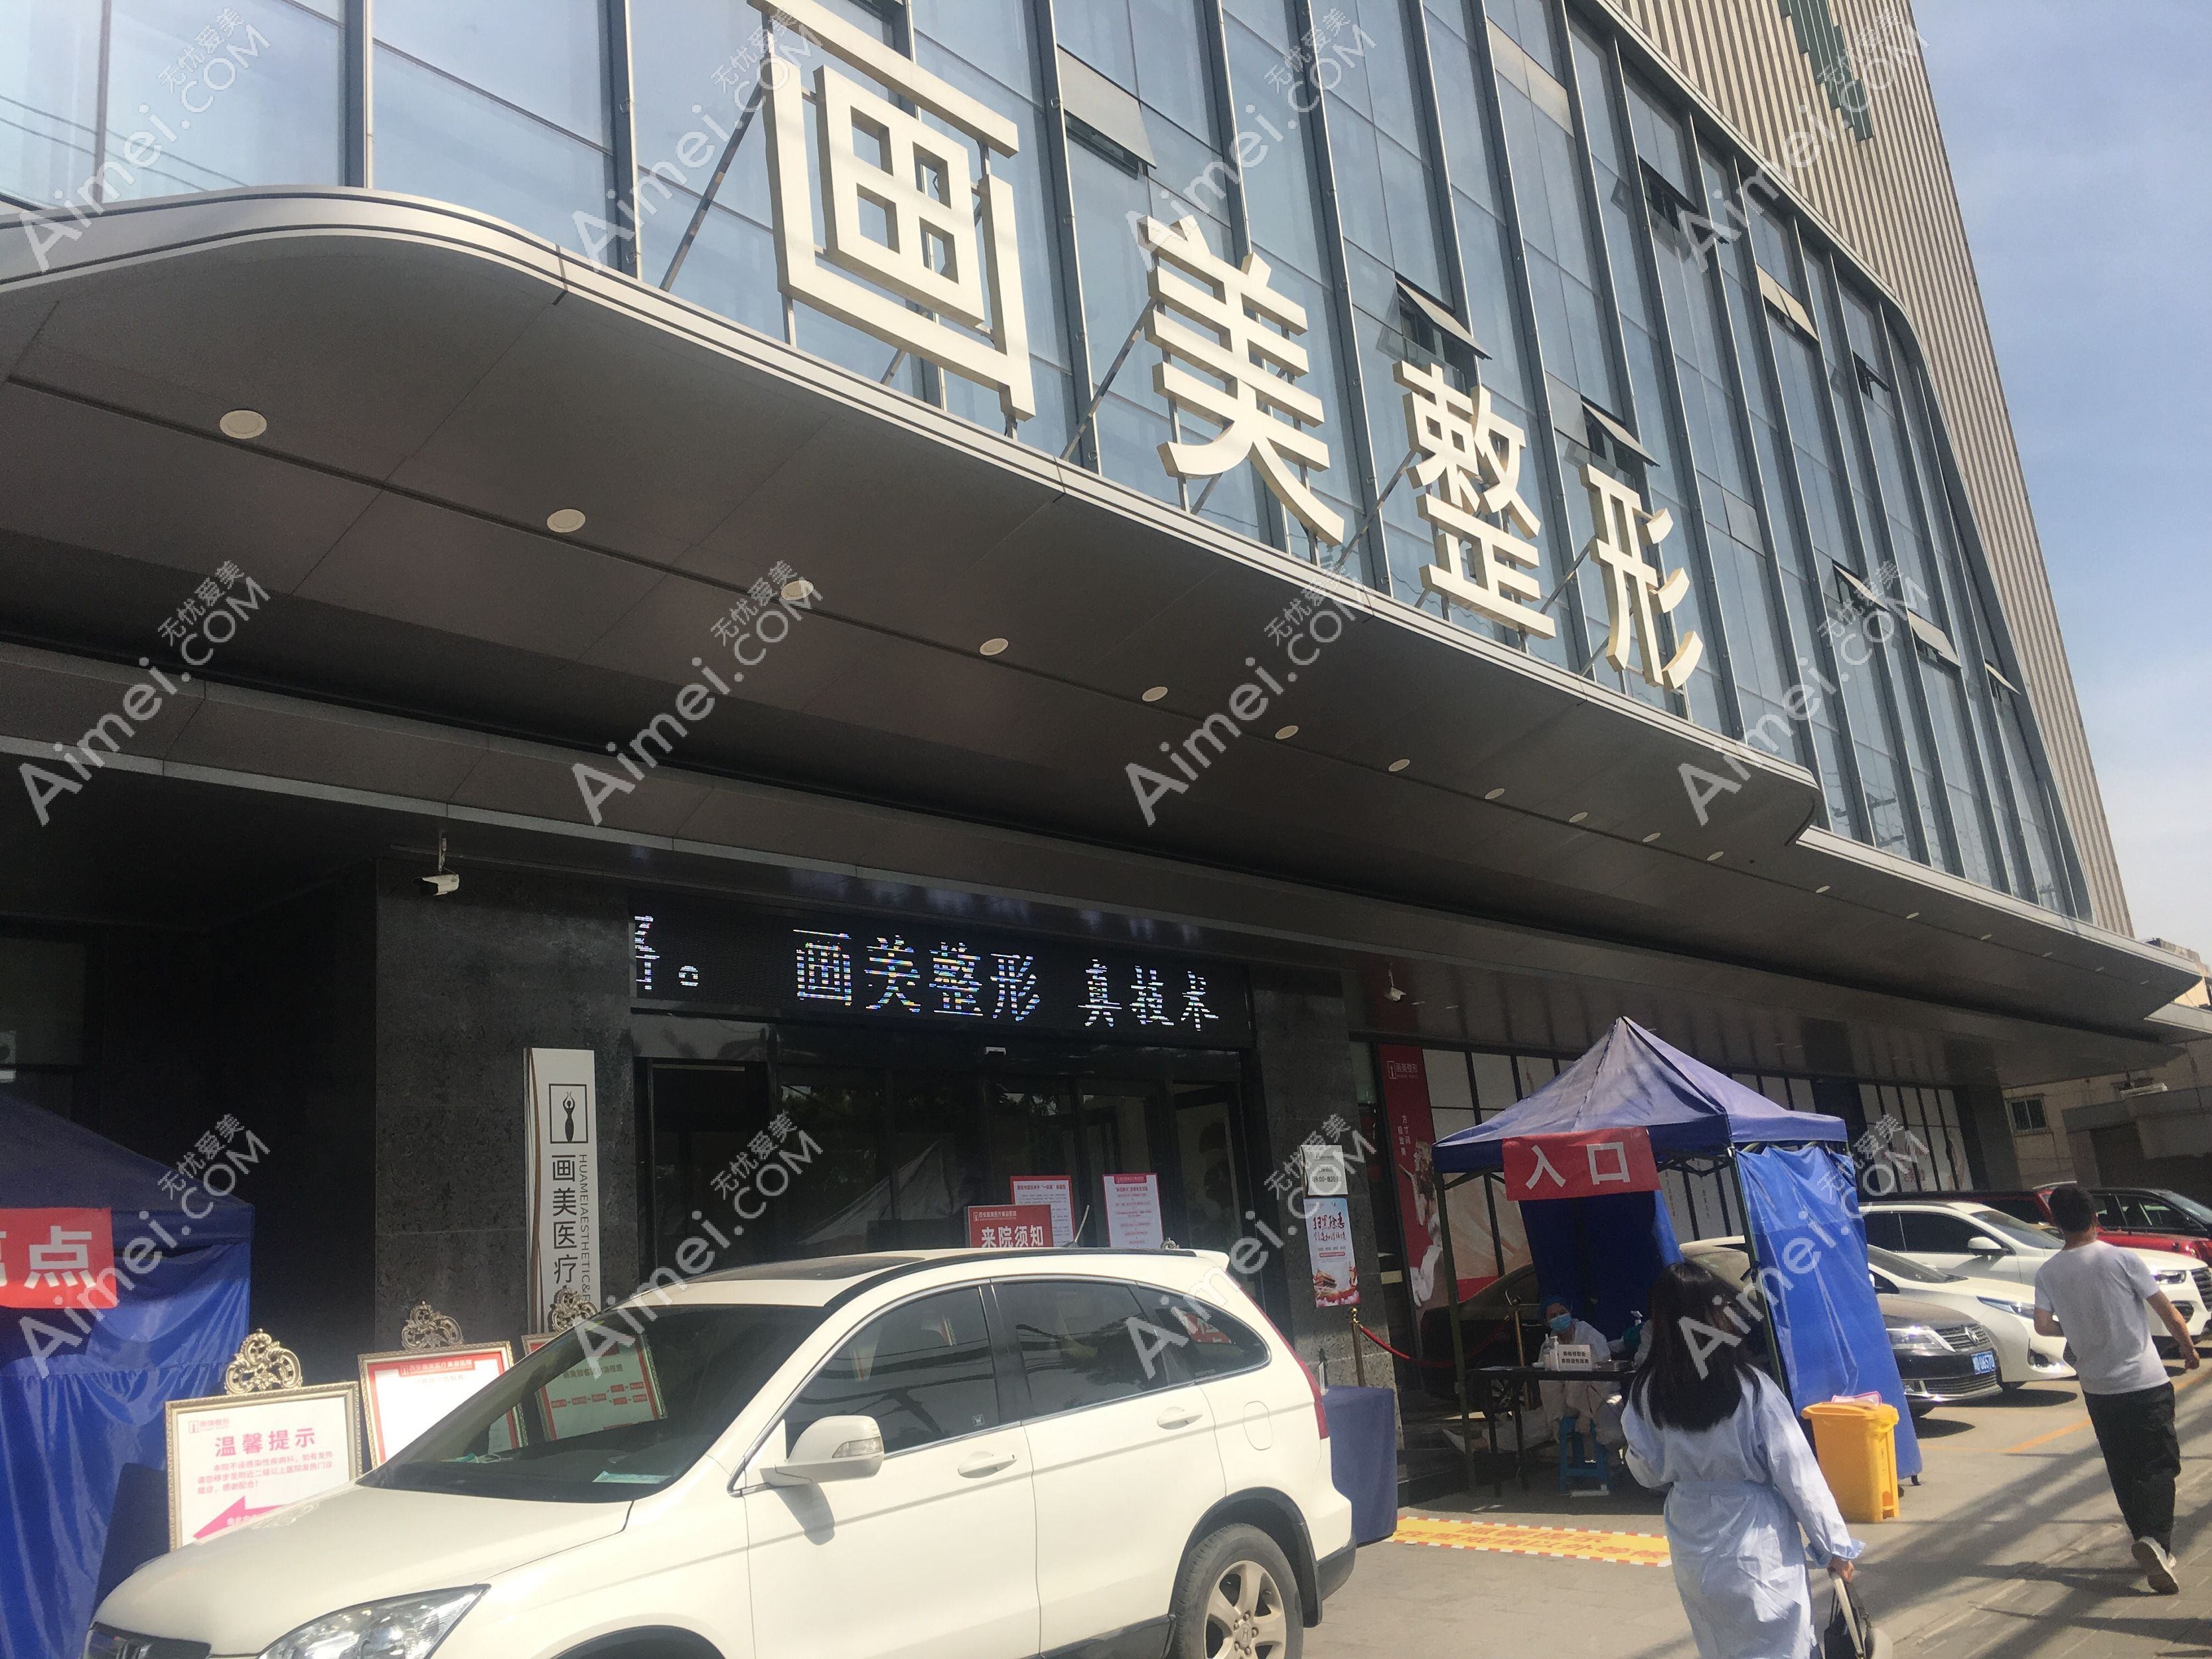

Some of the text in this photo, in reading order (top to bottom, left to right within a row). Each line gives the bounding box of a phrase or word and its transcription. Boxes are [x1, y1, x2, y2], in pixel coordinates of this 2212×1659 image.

[747, 0, 1703, 690] 画美整形
[793, 928, 1040, 1021] 画美整形
[1077, 958, 1219, 1031] 真技术
[1525, 1141, 1631, 1190] 入口
[551, 1155, 579, 1285] 画美医疗
[981, 1224, 1044, 1248] 来院须知
[0, 1226, 97, 1289] 点
[214, 1427, 315, 1457] 温馨提示
